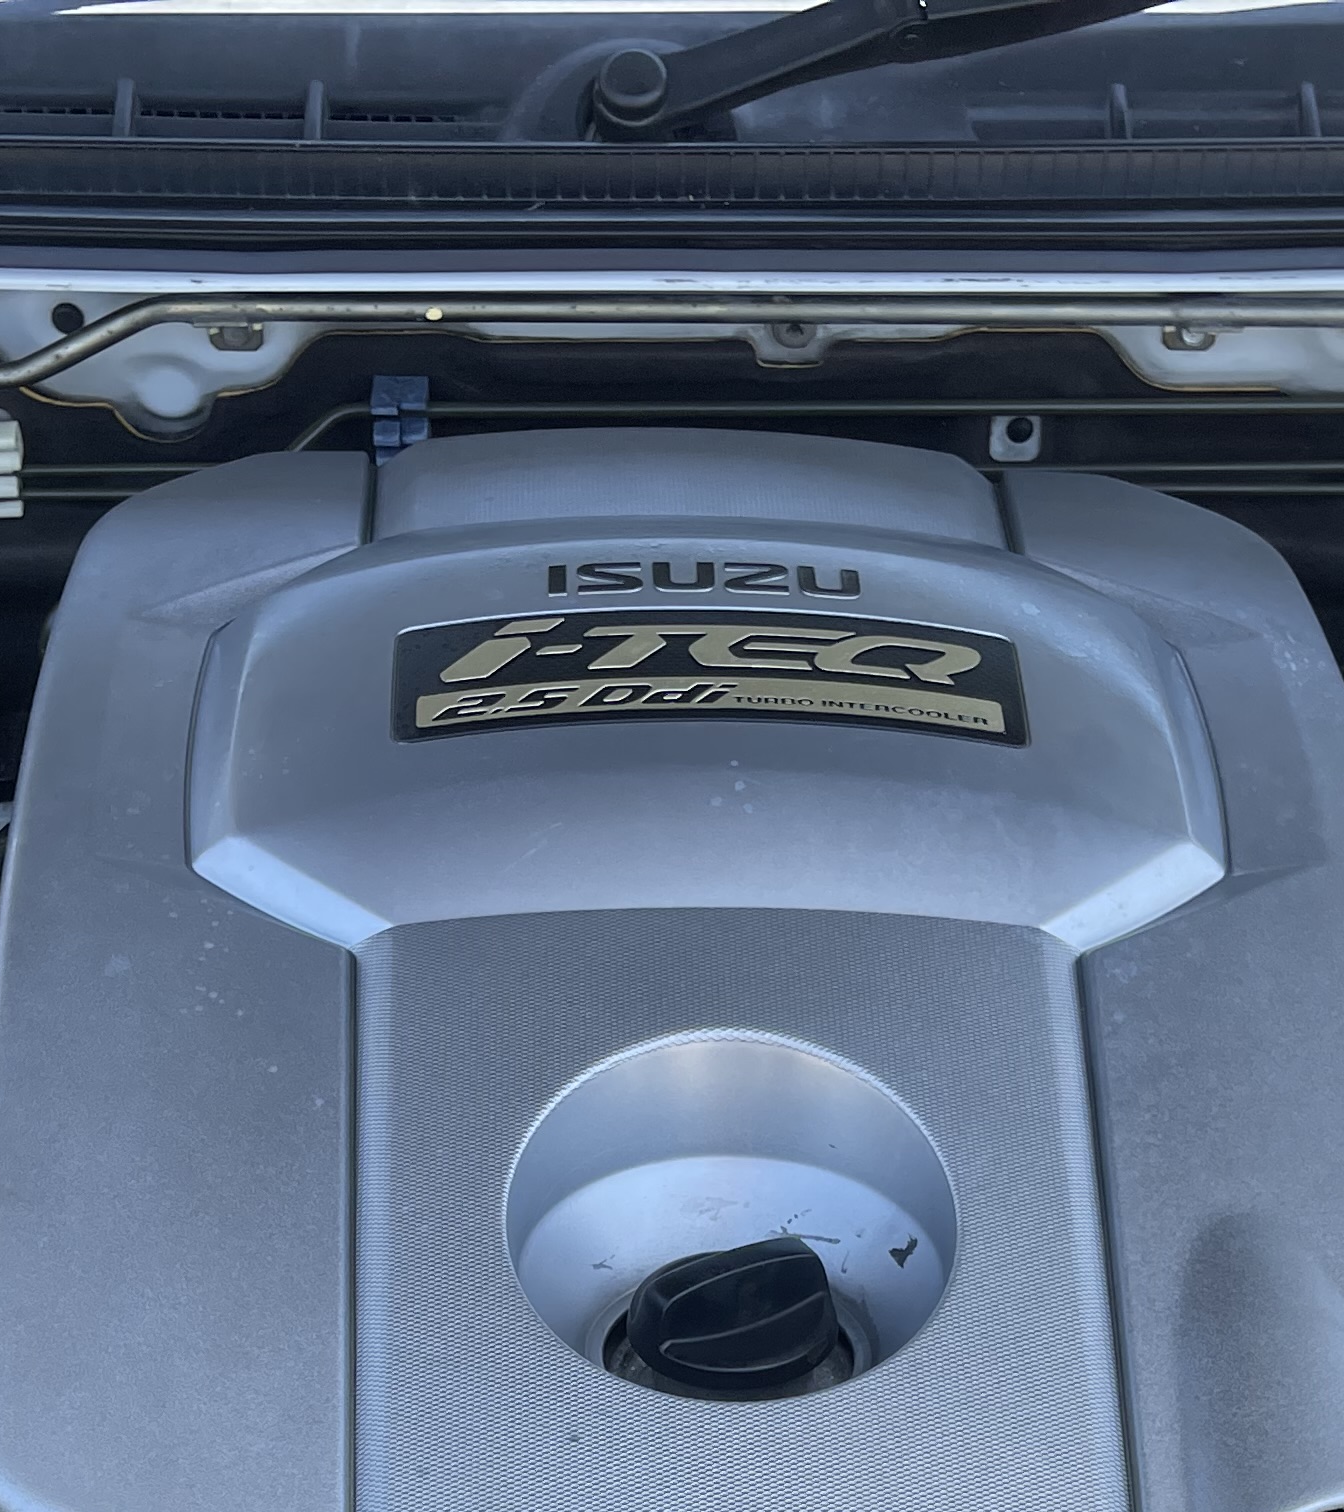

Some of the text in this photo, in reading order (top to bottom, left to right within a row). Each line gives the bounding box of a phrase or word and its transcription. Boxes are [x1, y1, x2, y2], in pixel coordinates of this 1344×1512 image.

[547, 560, 862, 600] ISUZU
[431, 684, 586, 721] 2.5
[732, 695, 815, 709] TURBO
[820, 699, 991, 727] INTERCOOLER
